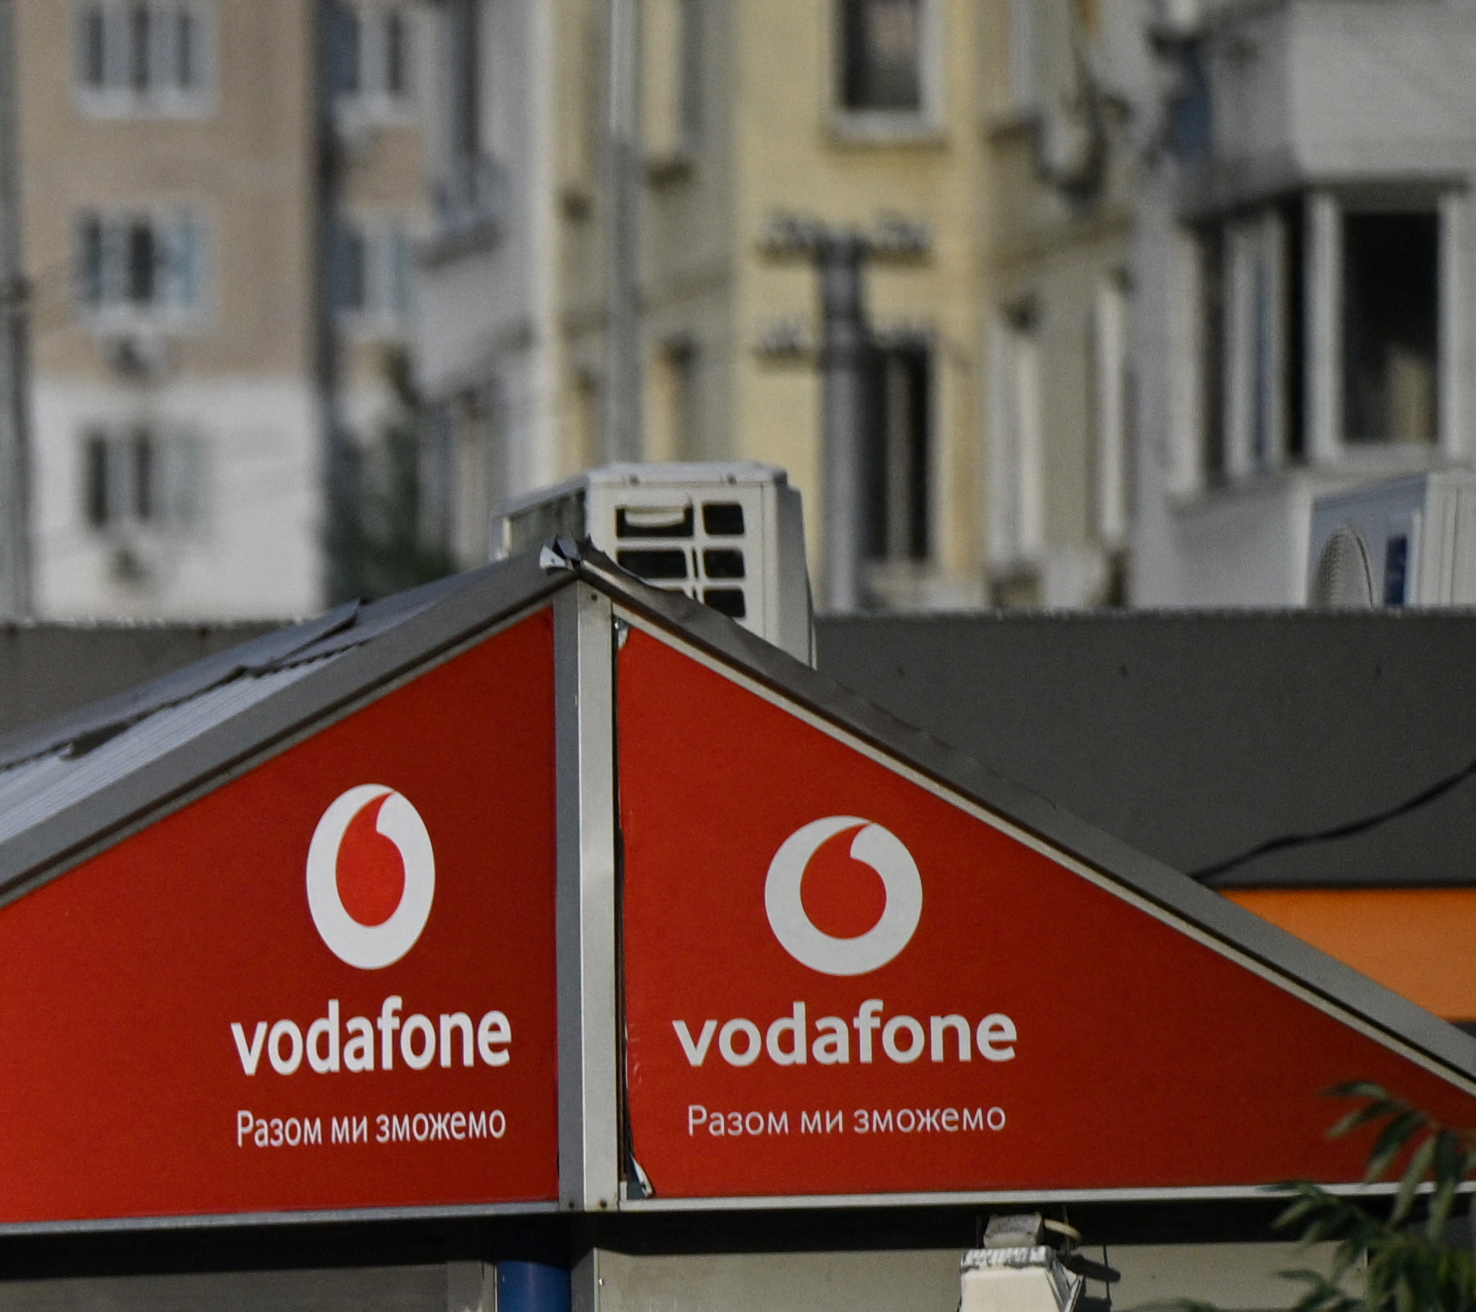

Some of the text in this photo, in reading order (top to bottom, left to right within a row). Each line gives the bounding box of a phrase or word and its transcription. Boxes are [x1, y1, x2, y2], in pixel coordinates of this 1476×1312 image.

[231, 995, 512, 1077] vodafone
[672, 998, 1017, 1068] vodafone
[237, 1106, 507, 1149] Разом ми зможемо
[688, 1103, 1007, 1138] Разом ми зможемо
